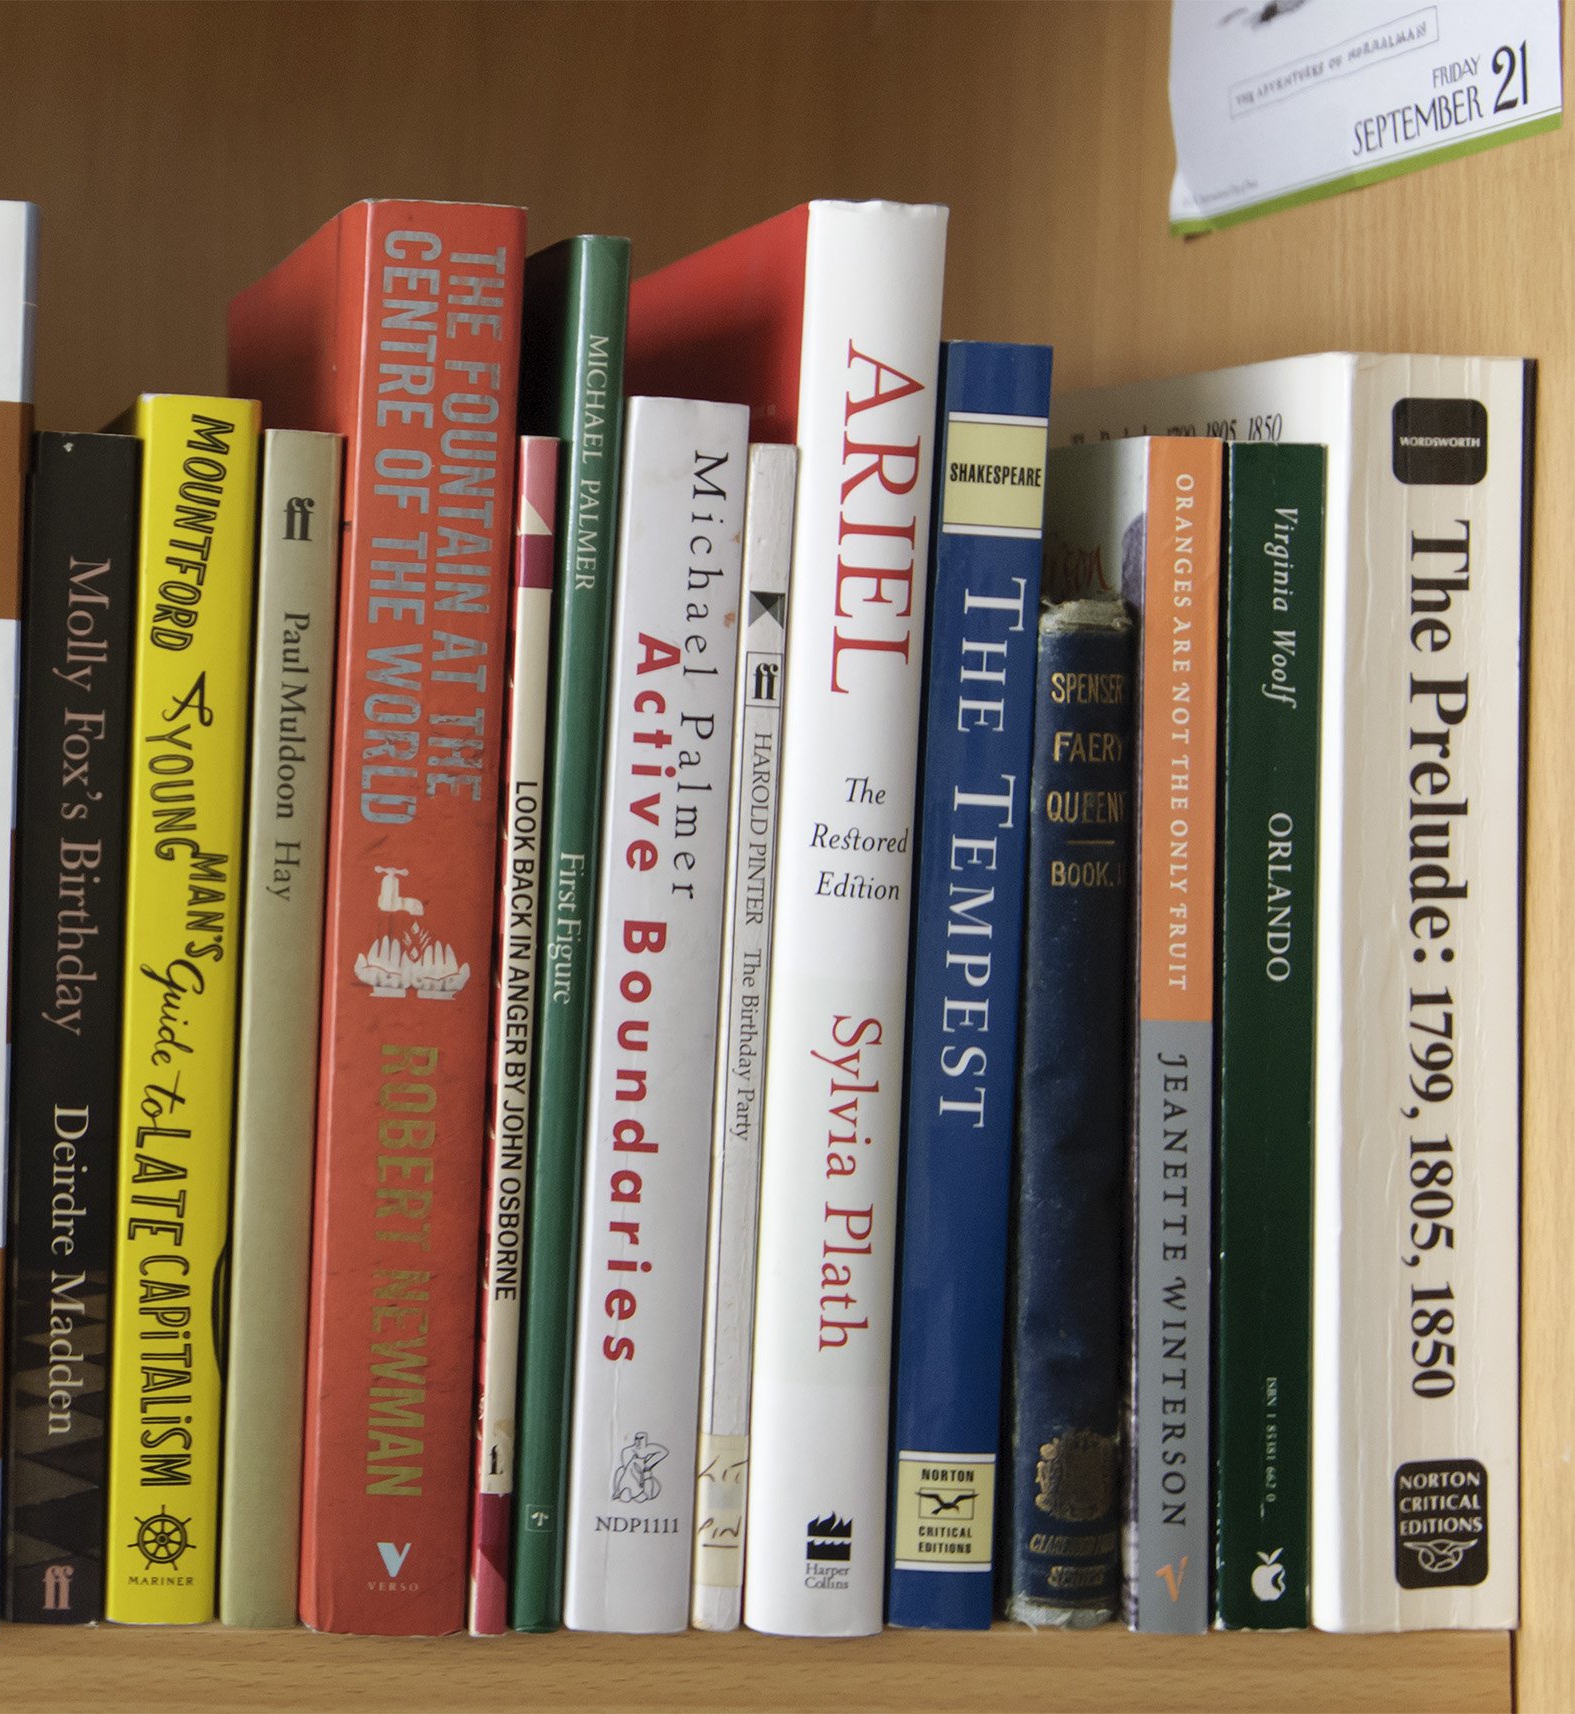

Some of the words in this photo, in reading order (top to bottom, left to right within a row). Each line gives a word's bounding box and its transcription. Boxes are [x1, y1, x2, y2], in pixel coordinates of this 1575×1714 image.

[1353, 85, 1484, 156] SEPTEMBER
[1491, 41, 1528, 114] 21
[1432, 54, 1482, 89] FRIDAY
[581, 333, 609, 464] MICHAEL
[1400, 437, 1481, 449] WORDSWORTH
[830, 338, 925, 696] ARIEL
[949, 462, 1042, 488] SHAKESPEARE
[574, 478, 604, 593] PALMER
[682, 450, 729, 676] Michael
[1173, 473, 1194, 608] ORANGES
[1263, 508, 1299, 612] Virginia
[1410, 519, 1470, 652] The
[52, 556, 111, 692] Molly
[282, 613, 310, 674] Paul
[957, 577, 1027, 732] THE
[1261, 630, 1297, 710] Woolf
[60, 707, 106, 820] Fox's
[276, 683, 307, 819] Muldoon
[625, 632, 682, 872] Active
[750, 732, 773, 836] HAROLD
[846, 776, 887, 806] The
[513, 781, 539, 852] LOOK
[664, 712, 715, 900] Palmer
[810, 825, 910, 855] Restored
[1408, 673, 1469, 963] Prelude:
[266, 841, 302, 901] Hay
[511, 859, 535, 928] BACK
[557, 851, 585, 913] First
[745, 842, 767, 925] PINTER
[817, 871, 901, 902] Edition
[1266, 812, 1293, 982] ORLANDO
[41, 837, 102, 1036] Birthday
[547, 916, 582, 1005] Figure
[742, 948, 762, 988] The
[939, 774, 1016, 1128] TEMPEST
[1168, 902, 1188, 990] FRUIT
[506, 966, 530, 1055] ANGER
[732, 993, 760, 1080] Birthday
[1401, 989, 1454, 1120] 1799,
[501, 1100, 525, 1170] JOHN
[602, 919, 668, 1362] Boundaries
[730, 1088, 754, 1141] Party
[810, 1015, 884, 1178] Sylvia
[50, 1103, 90, 1256] Deirdre
[1157, 1052, 1189, 1261] JEANETTE
[1404, 1137, 1454, 1268] 1805,
[496, 1177, 522, 1300] OSBORNE
[819, 1203, 874, 1350] Plath
[48, 1271, 86, 1435] Madden
[1411, 1286, 1455, 1399] 1850
[1161, 1276, 1187, 1527] WINTERSON
[595, 1516, 679, 1534] NDP1111
[921, 1468, 975, 1482] NORTON
[1400, 1471, 1480, 1489] NORTON
[1400, 1494, 1482, 1511] CRITICAL
[1401, 1516, 1483, 1534] EDITIONS
[804, 1574, 849, 1590] Collins
[805, 1563, 850, 1579] Harper
[918, 1525, 973, 1539] CRITICAL
[918, 1541, 971, 1555] EDITIONS
